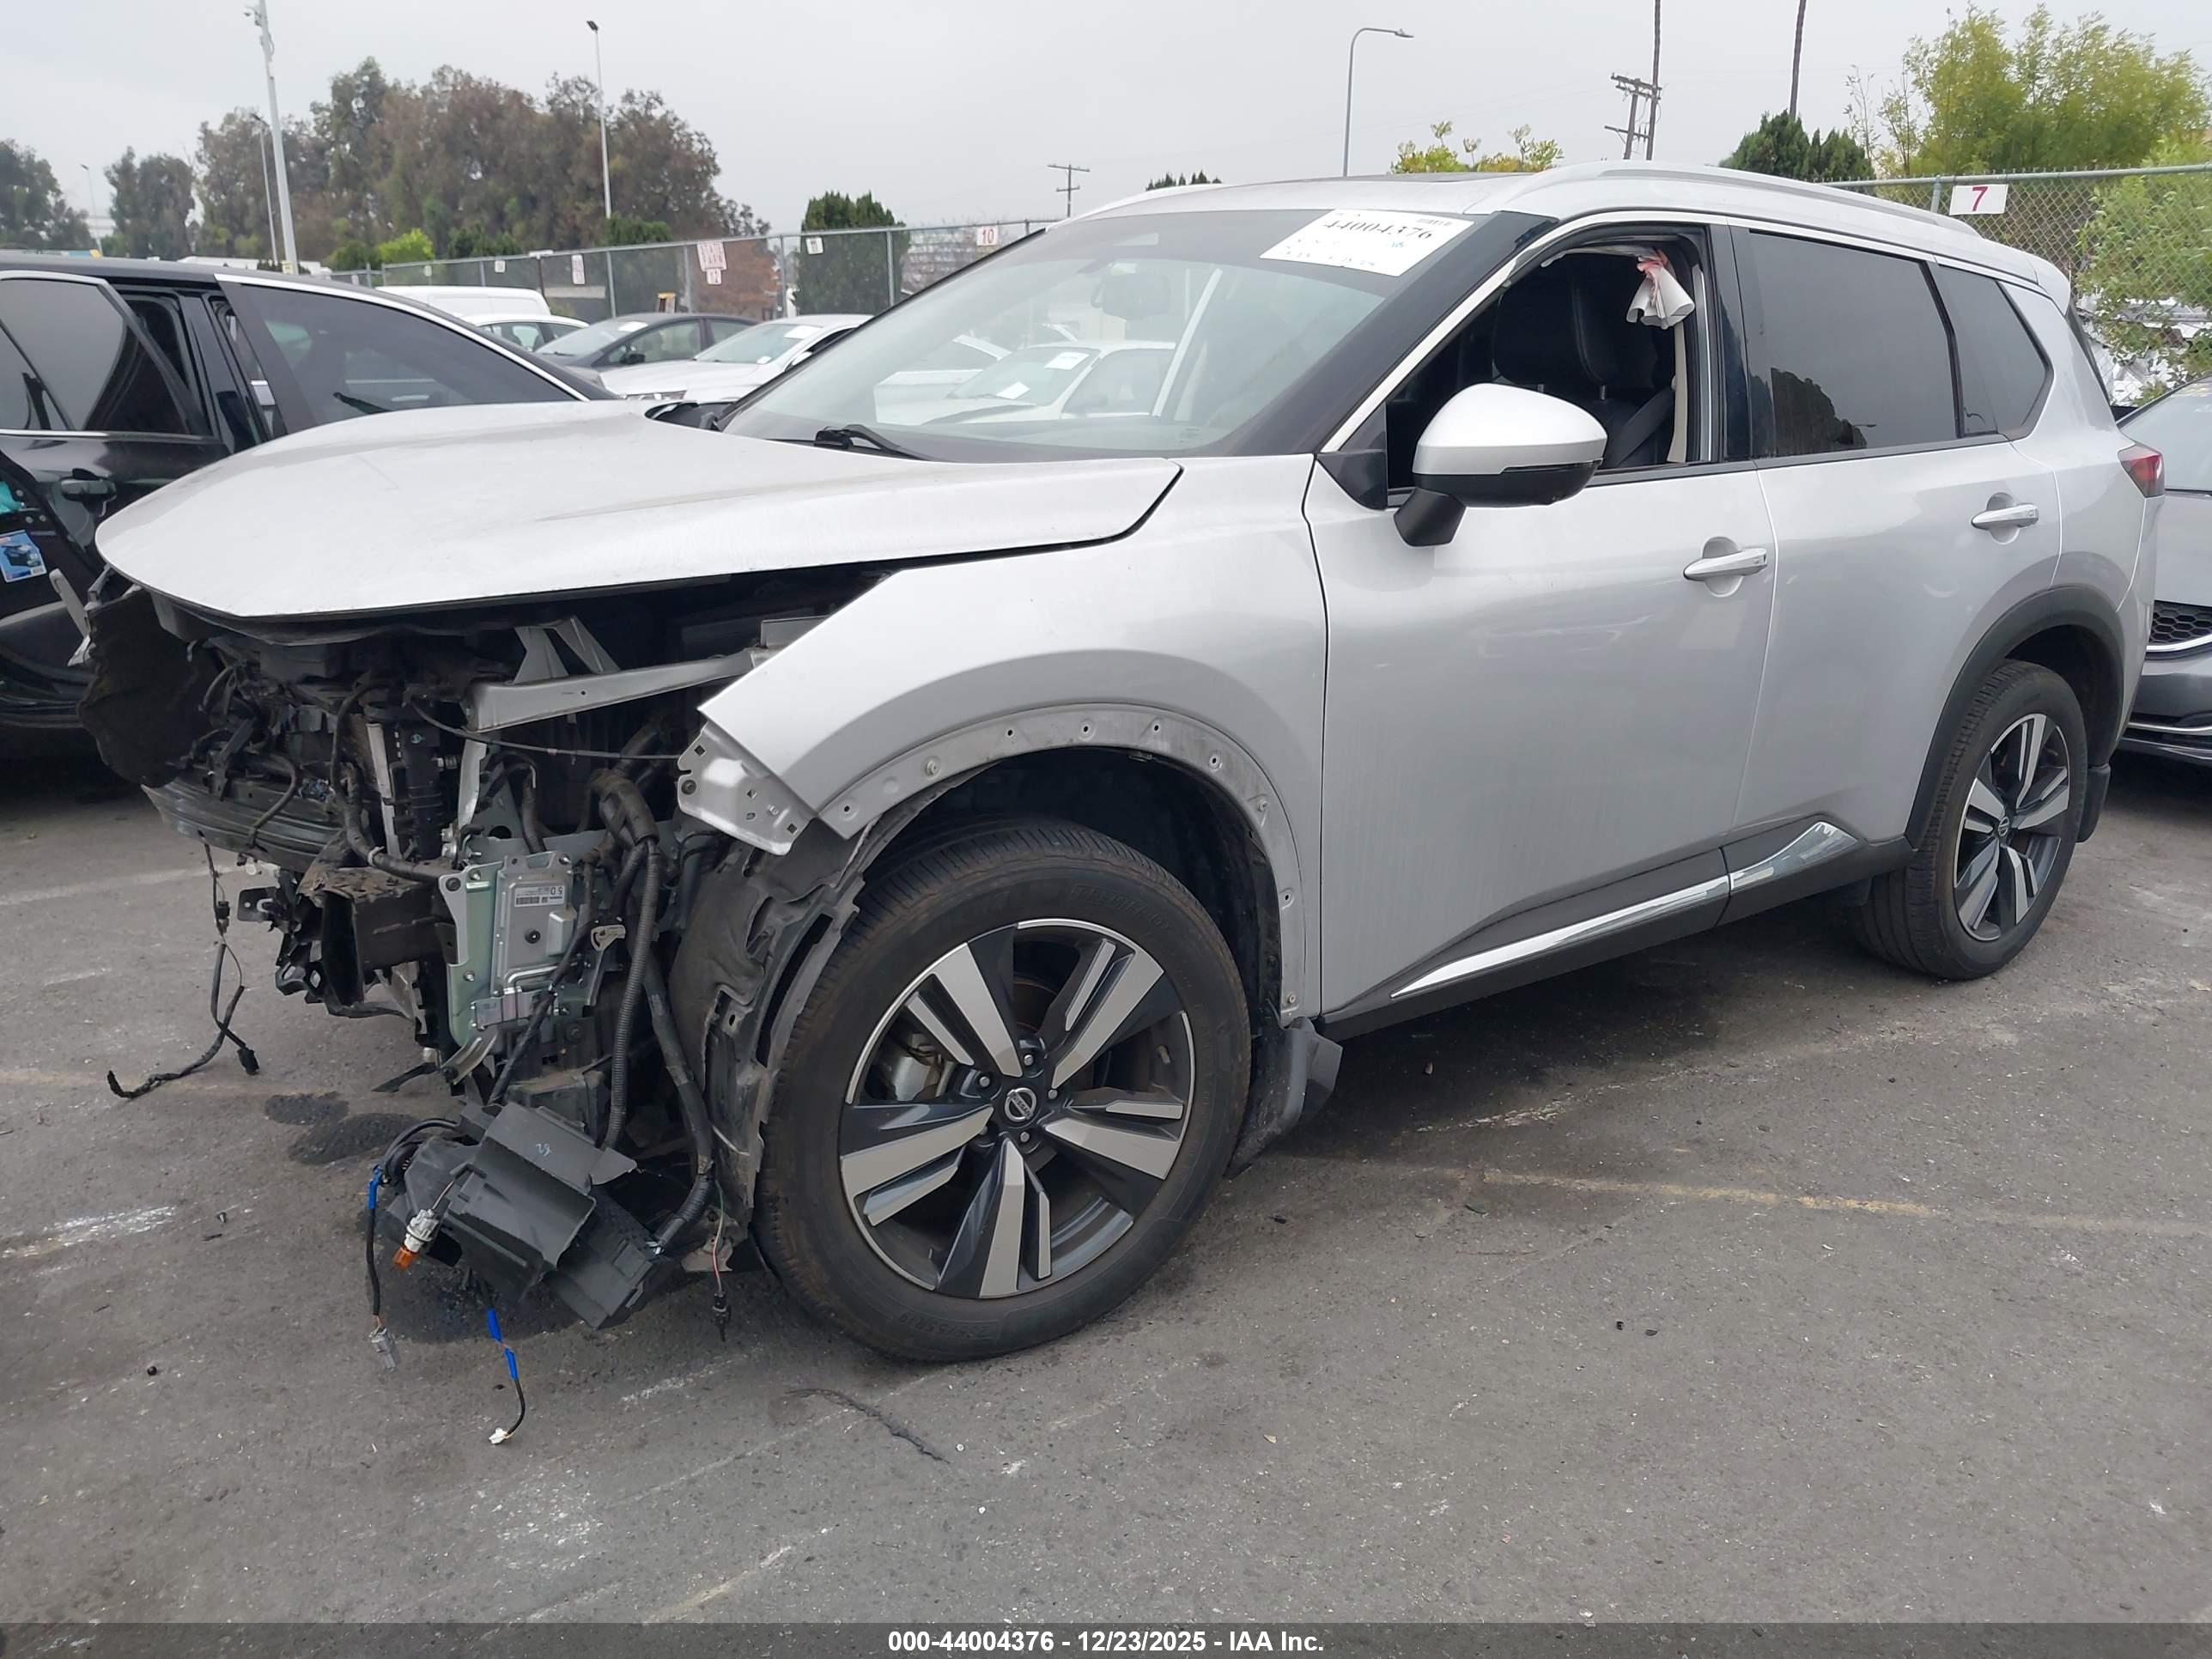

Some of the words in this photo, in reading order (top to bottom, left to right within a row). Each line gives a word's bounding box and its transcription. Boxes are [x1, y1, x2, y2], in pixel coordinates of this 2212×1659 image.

[1972, 185, 1989, 212] 7
[981, 228, 995, 245] 10
[1322, 219, 1433, 240] 44004376
